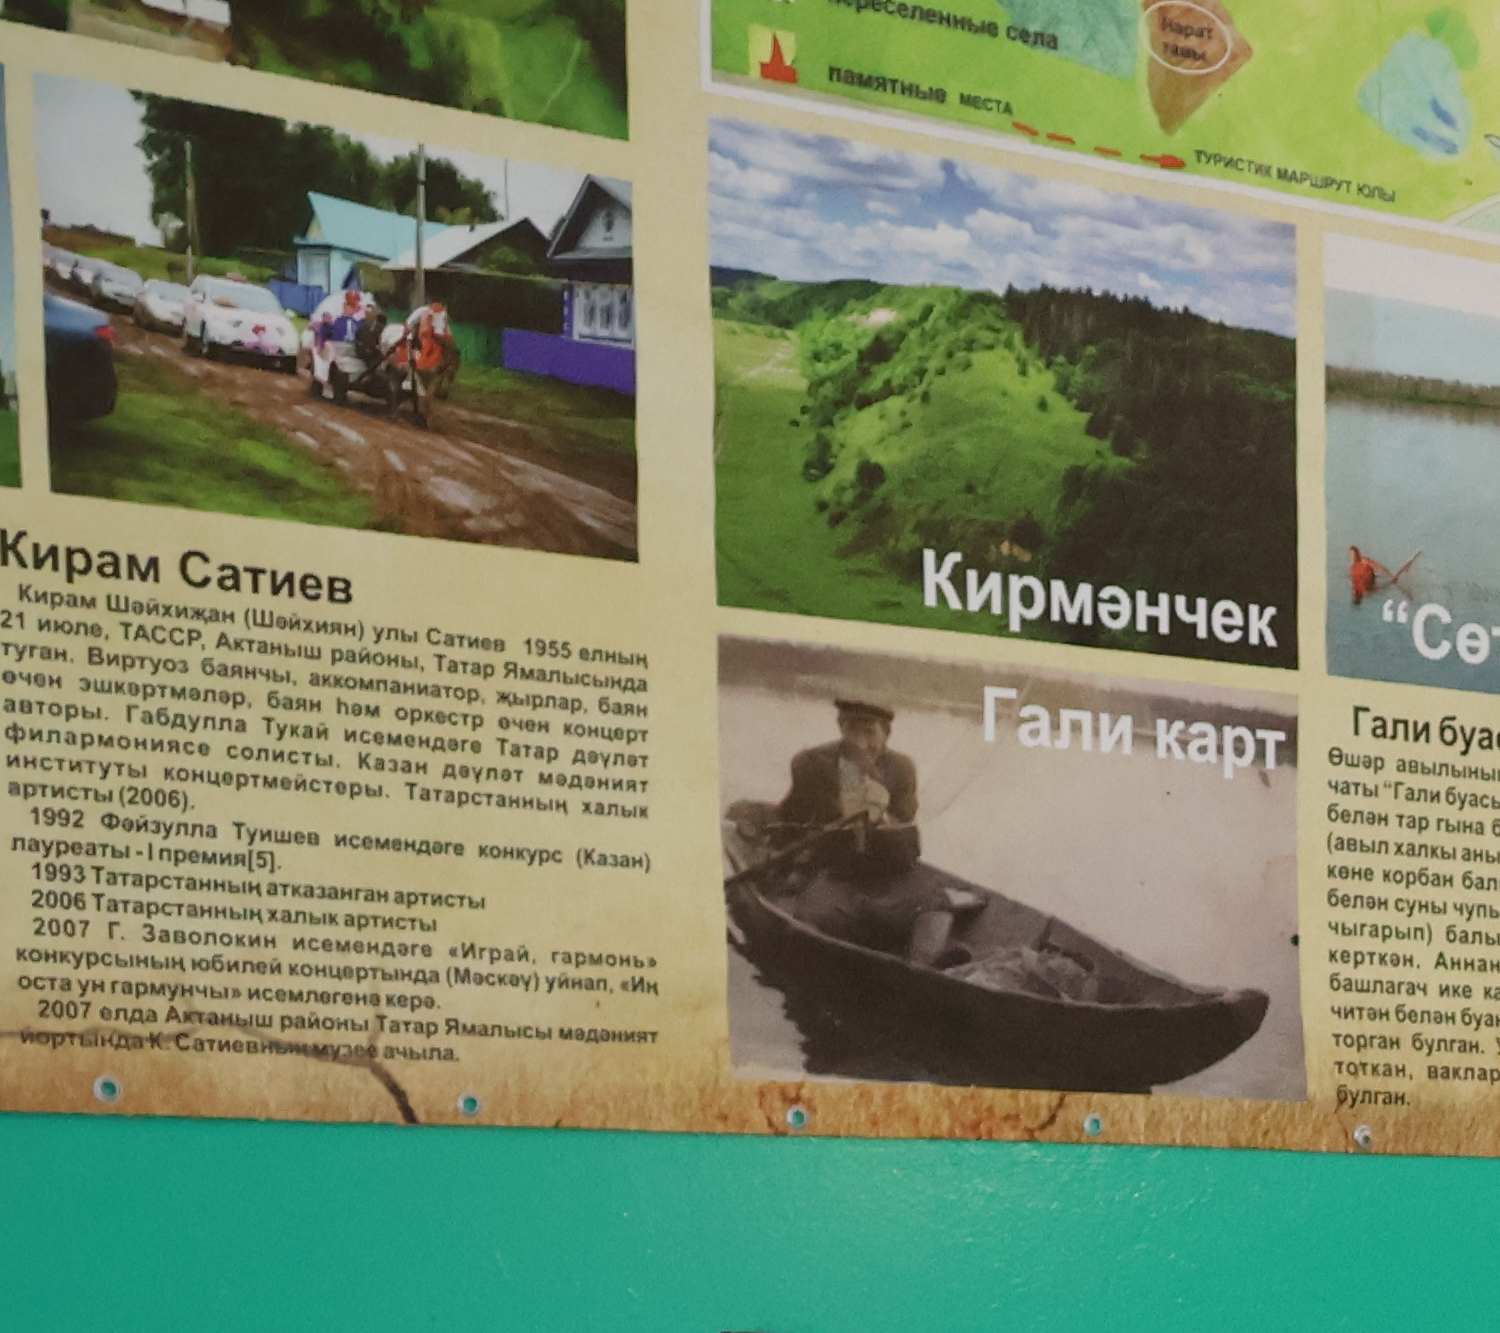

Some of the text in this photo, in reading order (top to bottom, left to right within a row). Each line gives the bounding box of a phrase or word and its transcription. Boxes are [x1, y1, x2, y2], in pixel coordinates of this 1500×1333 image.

[828, 0, 1059, 50] реселенные села
[828, 65, 947, 104] памятные
[1194, 149, 1273, 178] ТУРИСТИК
[1275, 166, 1352, 195] МАРШРУТ
[0, 527, 353, 605] Кирам Сатиев
[922, 548, 1278, 648] Кирмәнчек
[983, 685, 1286, 779] Гали карт
[1353, 704, 1431, 744] Гали
[1327, 745, 1385, 774] Өшәр
[1326, 802, 1389, 827] белән
[1395, 813, 1430, 834] тар
[1436, 817, 1485, 836] гына
[1328, 948, 1421, 969] керткән.
[1433, 950, 1500, 974] Аннан
